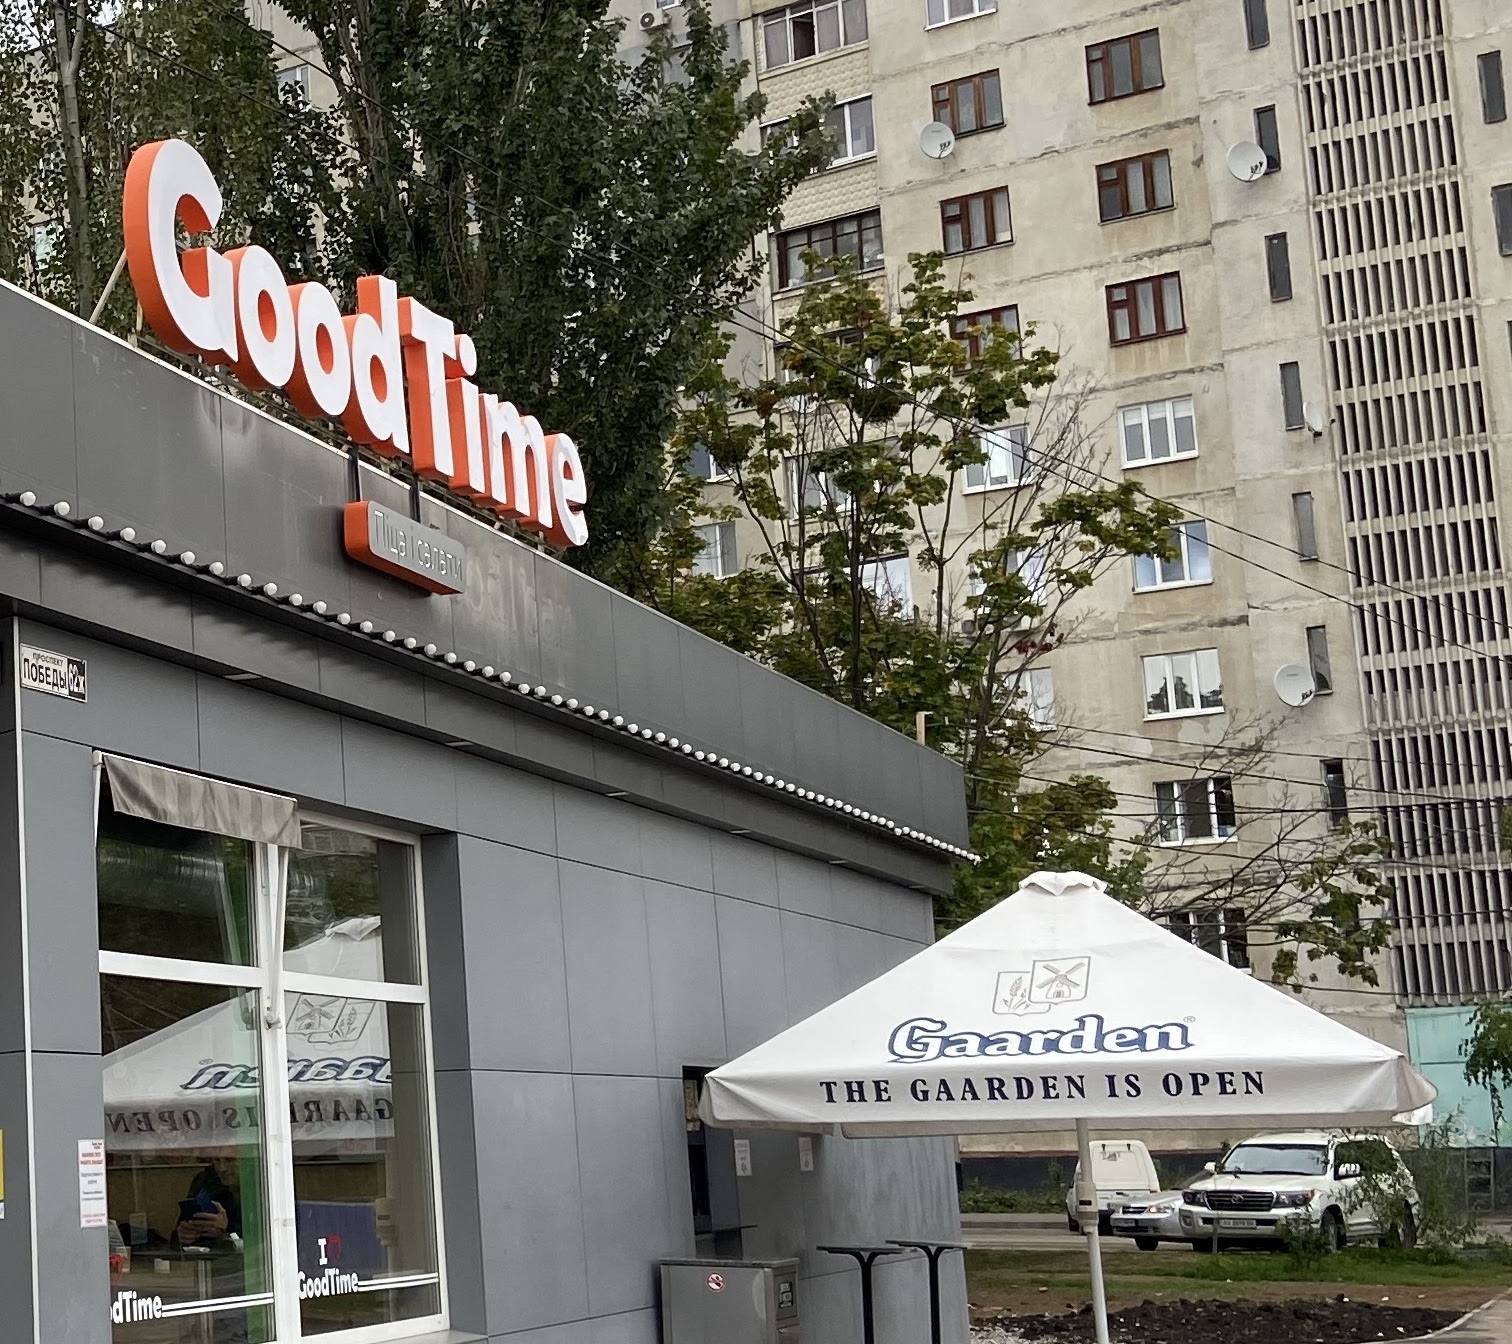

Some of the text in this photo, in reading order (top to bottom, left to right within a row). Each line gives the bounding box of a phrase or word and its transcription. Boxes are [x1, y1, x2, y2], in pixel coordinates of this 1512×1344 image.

[417, 540, 463, 581] салати
[23, 658, 67, 691] ПОБЕДЫ
[887, 1013, 1195, 1064] Gaarden
[819, 1070, 1266, 1105] THE GAARDEN IS OPEN
[298, 1268, 359, 1299] GoodTime
